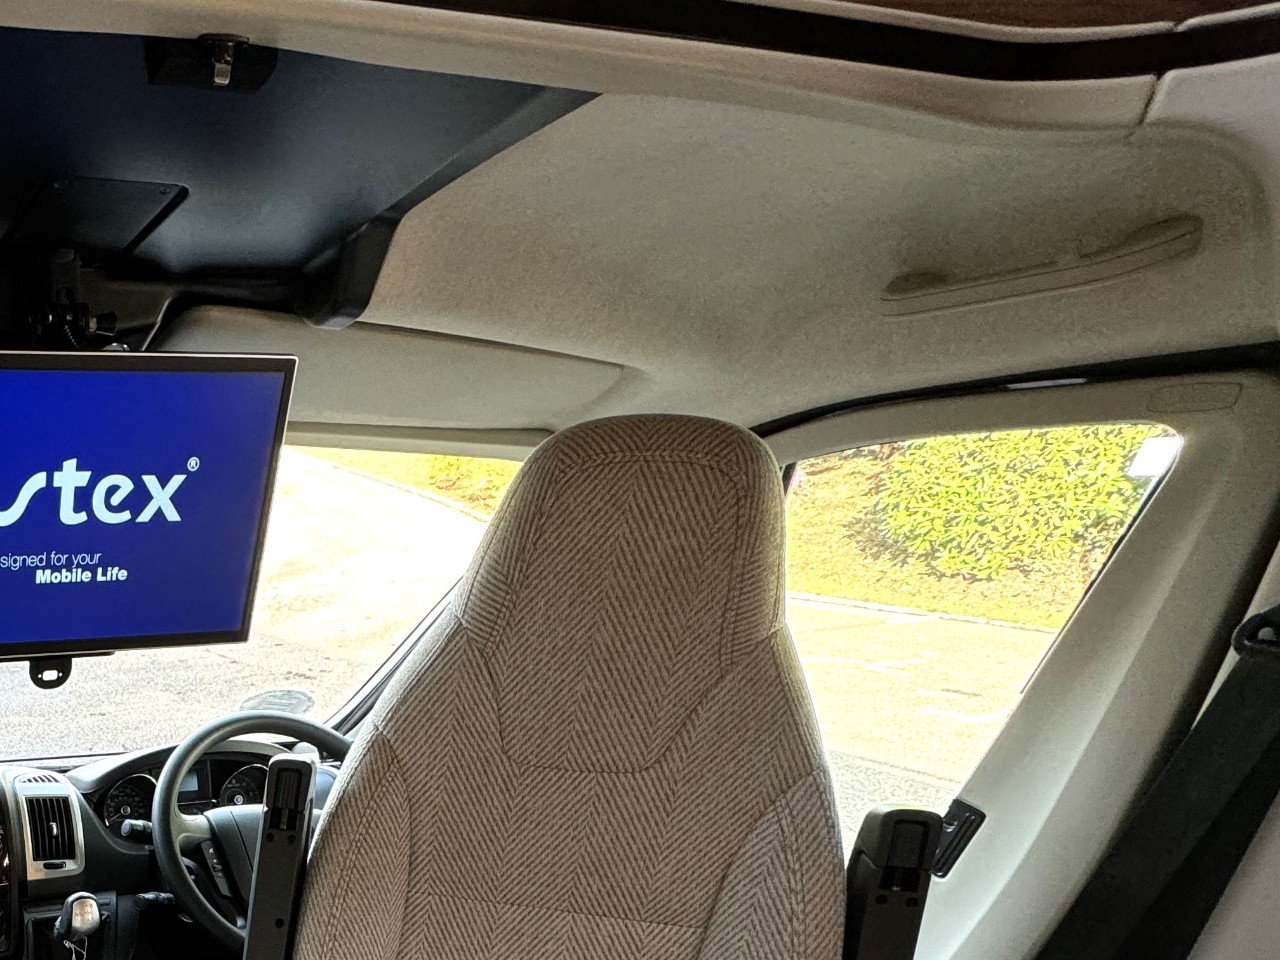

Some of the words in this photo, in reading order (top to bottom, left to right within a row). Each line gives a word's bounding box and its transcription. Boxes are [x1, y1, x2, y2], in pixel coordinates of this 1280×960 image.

[50, 551, 69, 566] for
[72, 552, 102, 568] your
[35, 568, 92, 584] Mobile
[96, 566, 128, 582] Life
